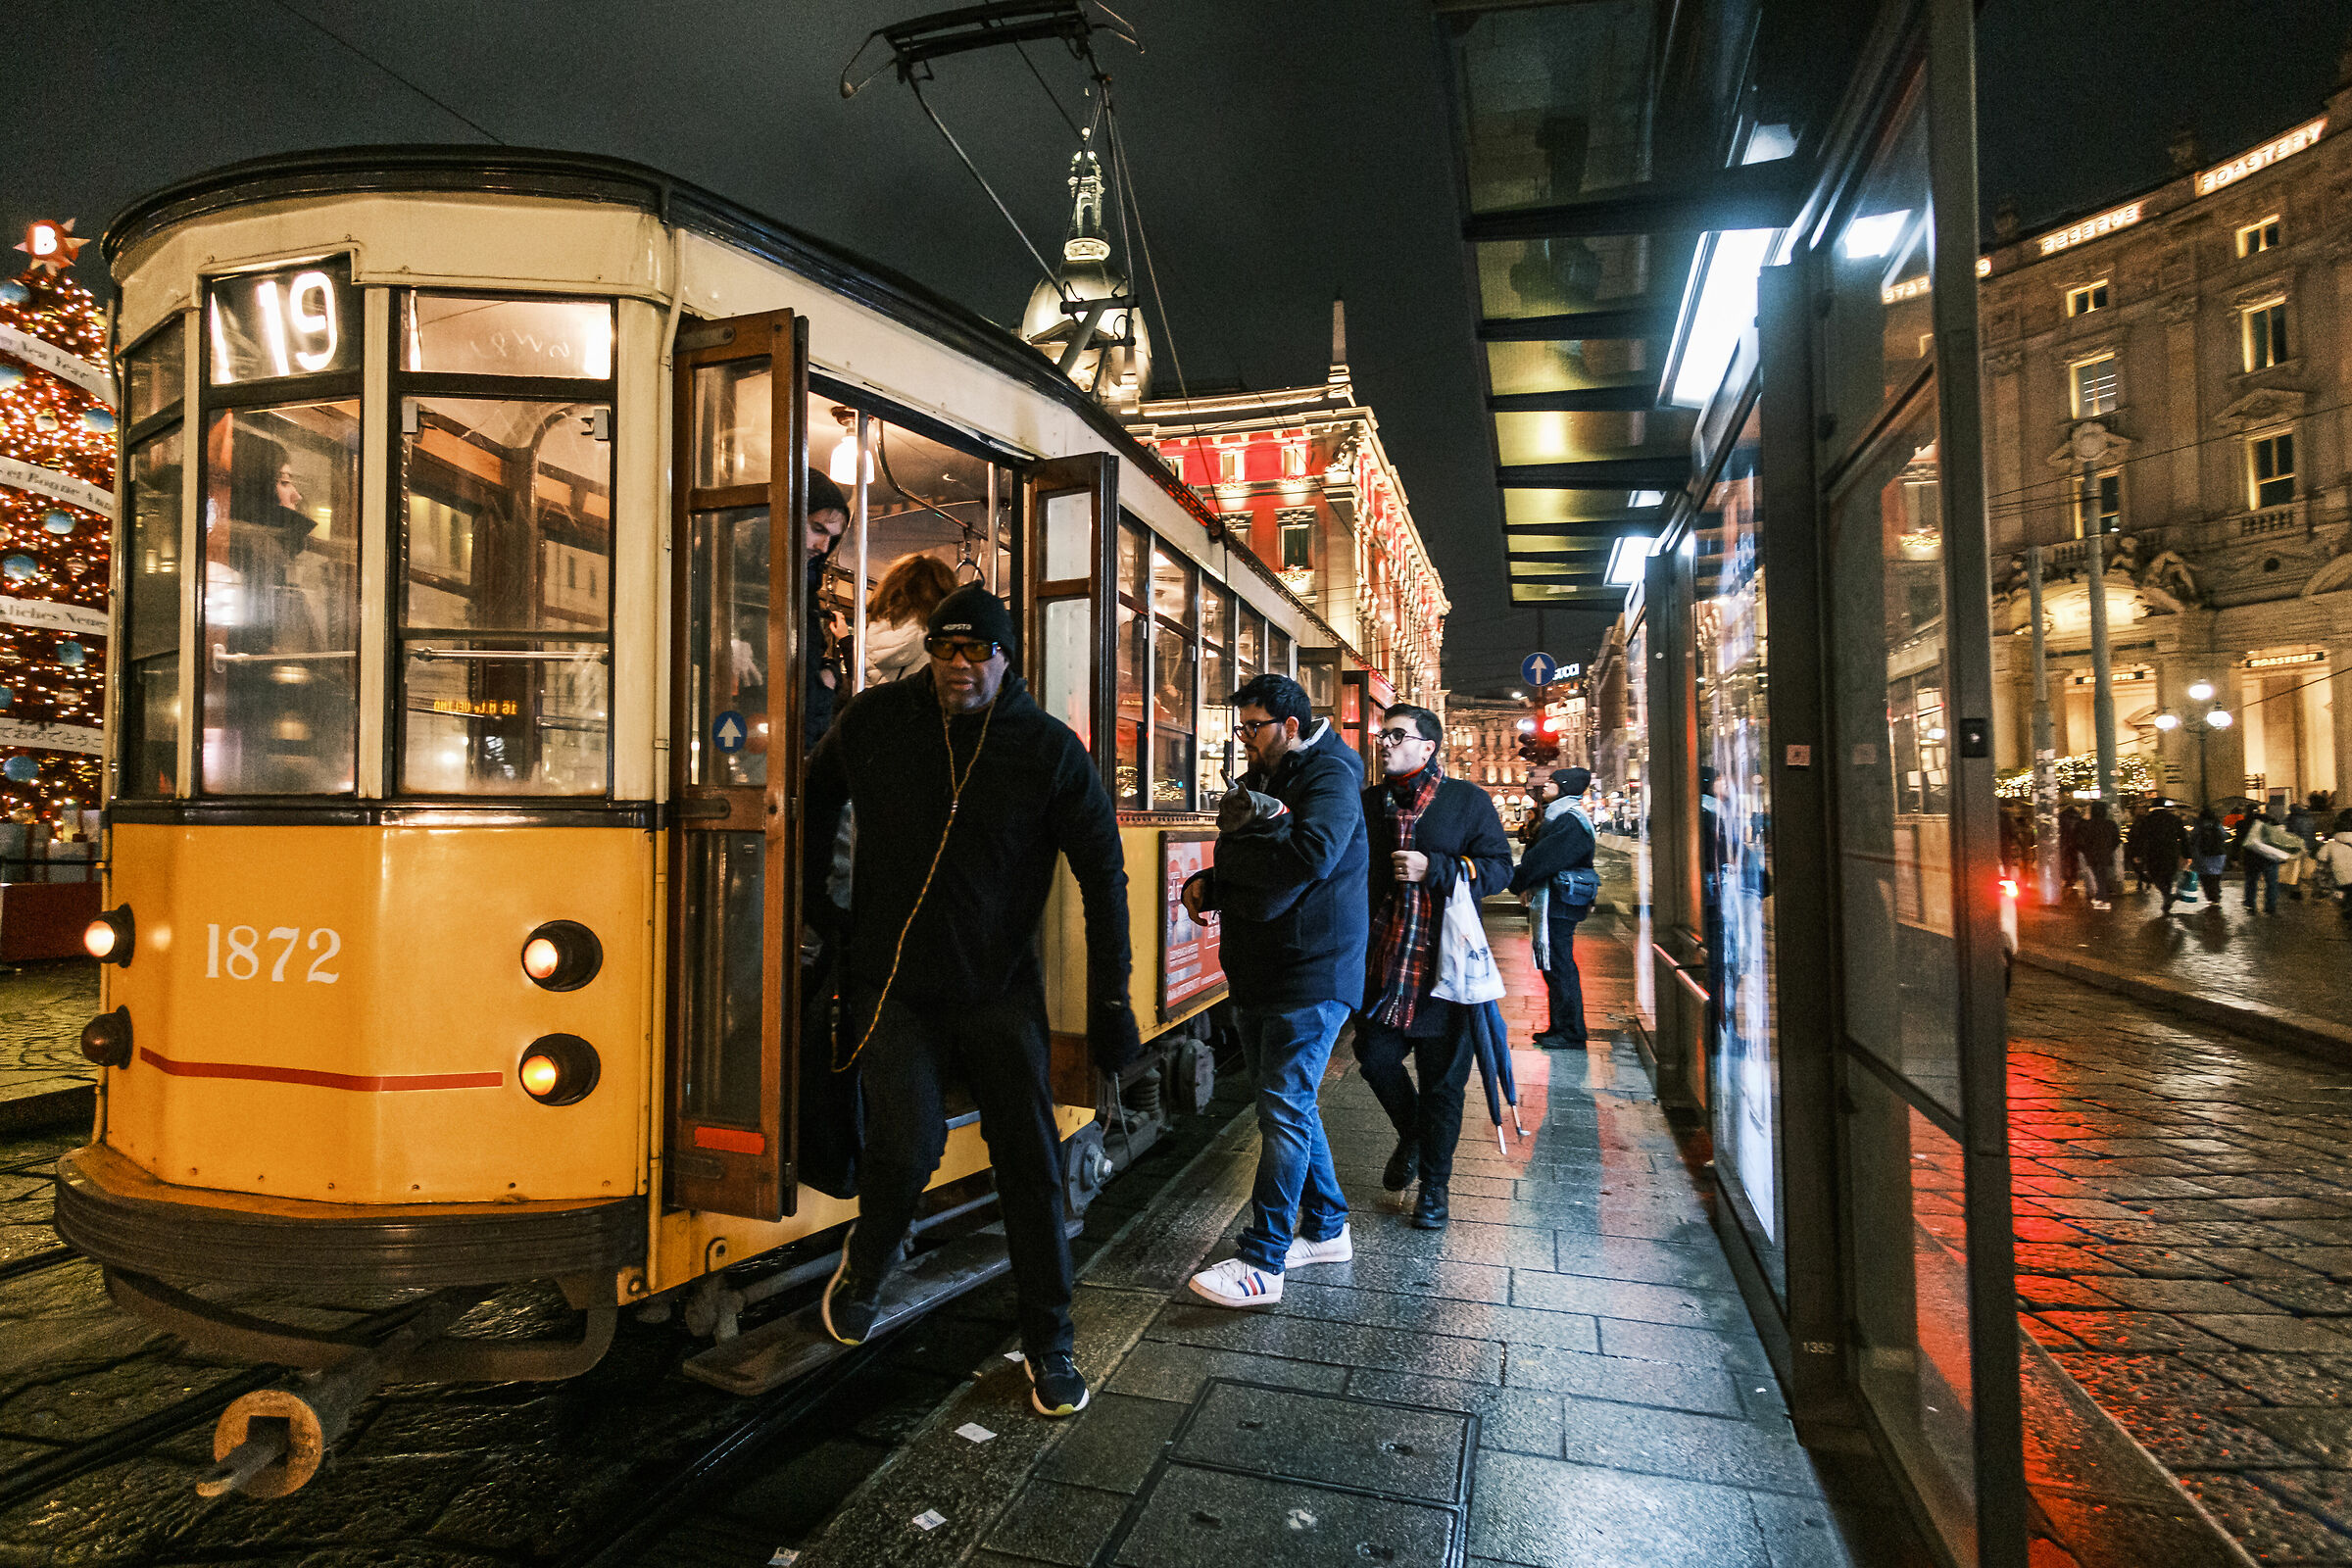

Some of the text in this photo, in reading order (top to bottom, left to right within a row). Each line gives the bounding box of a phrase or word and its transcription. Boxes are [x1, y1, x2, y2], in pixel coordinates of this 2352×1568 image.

[2198, 117, 2328, 195] ROASTERY
[34, 225, 57, 255] B
[2040, 203, 2141, 256] RESERVE
[257, 270, 338, 376] 19
[205, 923, 341, 984] 1872
